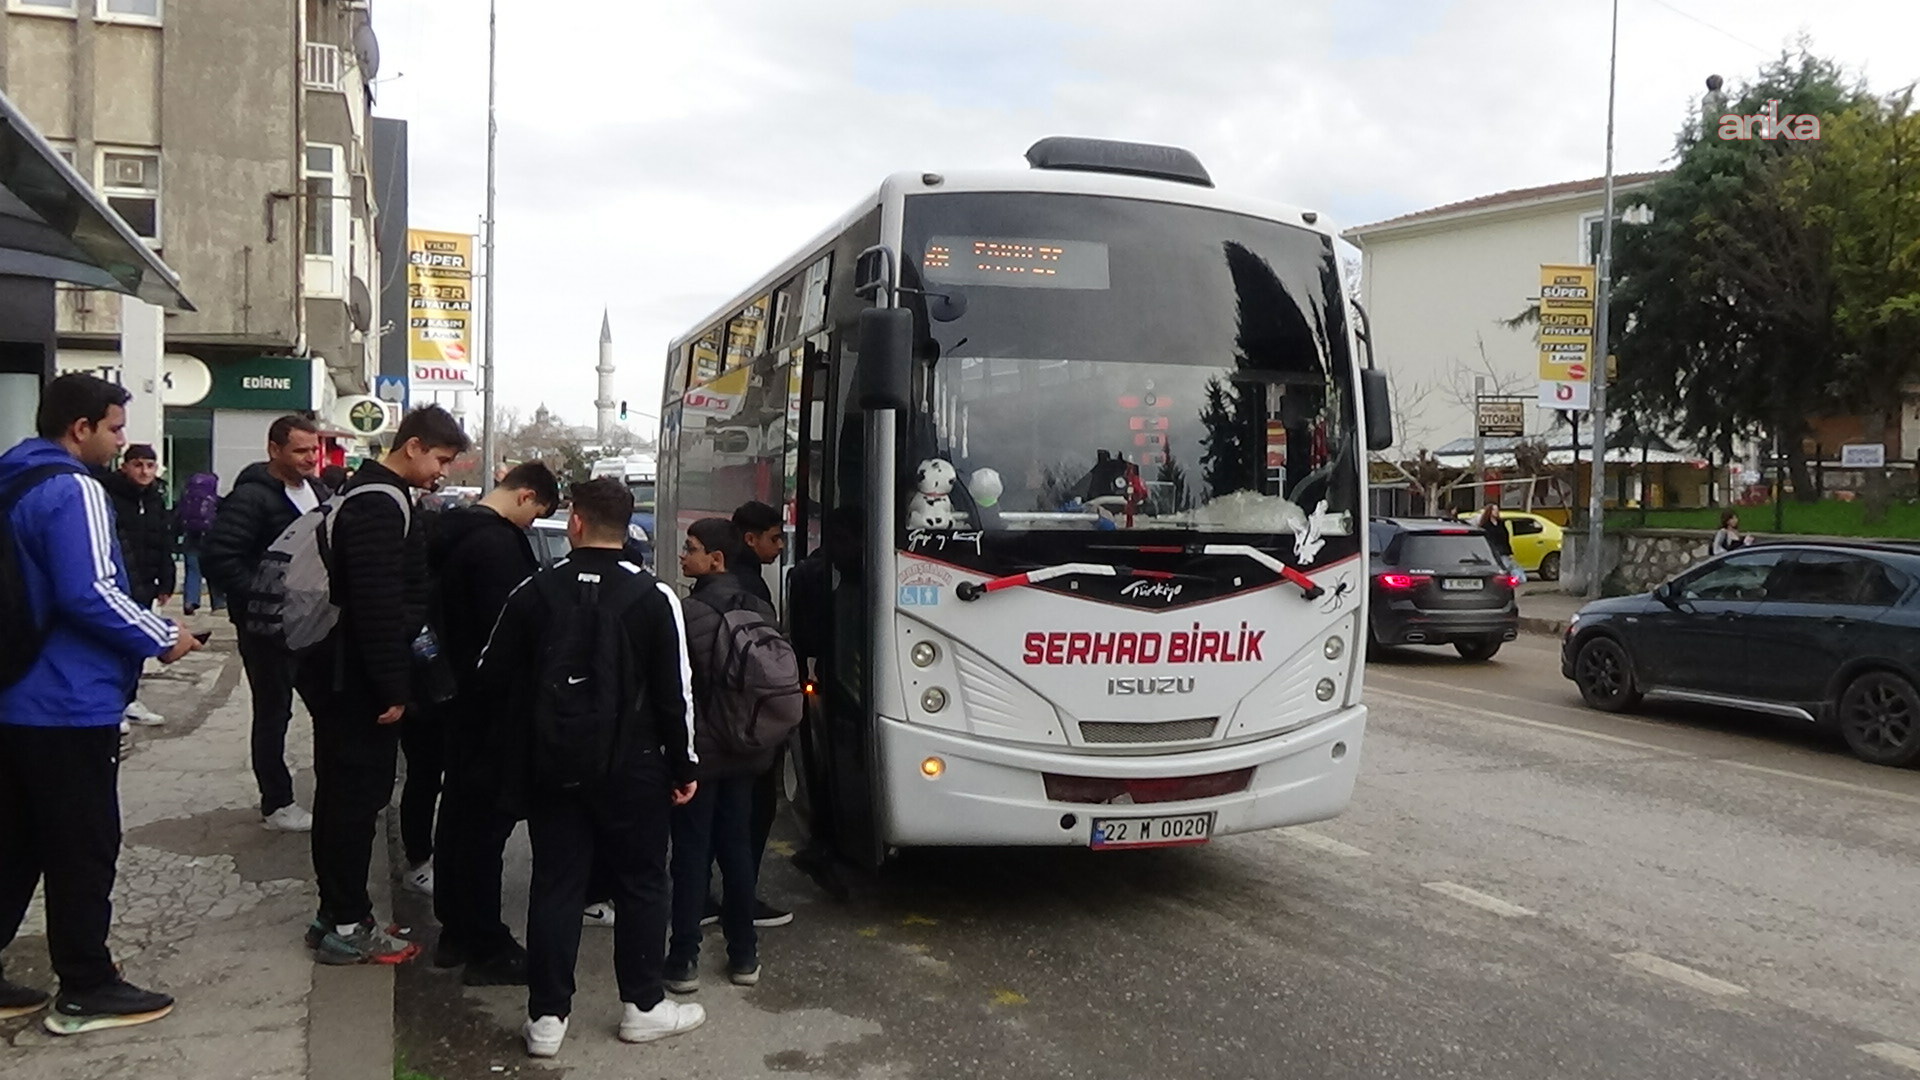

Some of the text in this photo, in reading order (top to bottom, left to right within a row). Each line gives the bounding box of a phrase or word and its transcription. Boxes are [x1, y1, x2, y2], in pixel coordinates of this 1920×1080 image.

[426, 241, 456, 250] YILIN
[411, 252, 463, 266] SÜPER
[409, 284, 463, 298] SÜPER
[1543, 286, 1587, 298] SÜPER
[412, 319, 462, 328] 27 KASIM
[1541, 314, 1587, 326] SÜPER
[1556, 343, 1585, 352] KASIM
[415, 366, 466, 380] onur
[242, 375, 291, 389] EDİRNE
[1480, 414, 1523, 424] OTOPARK
[1023, 620, 1266, 664] SERHAD BİRLİK
[1108, 676, 1195, 696] ISUZU
[1105, 817, 1205, 841] 22 M 0020
